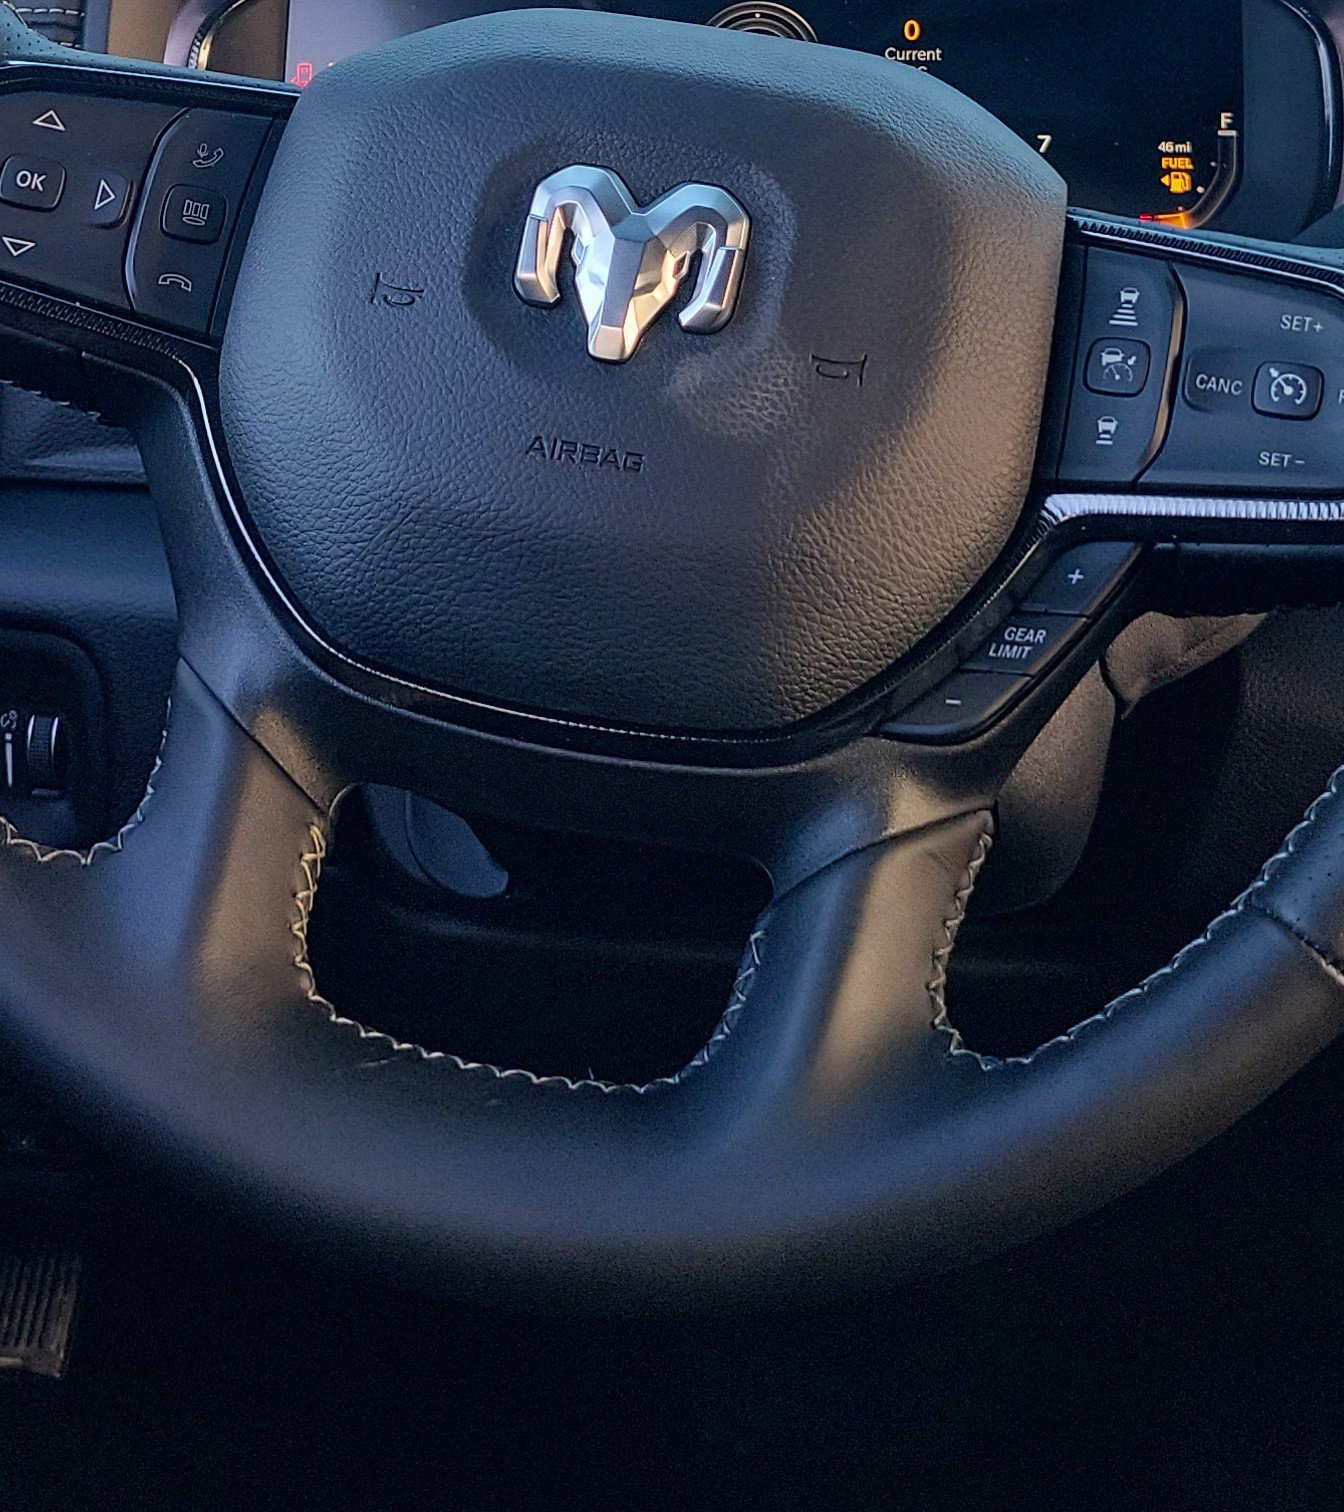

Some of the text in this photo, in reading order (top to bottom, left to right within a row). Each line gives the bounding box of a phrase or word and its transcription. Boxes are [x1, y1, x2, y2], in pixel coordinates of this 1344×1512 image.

[904, 19, 921, 41] 0
[885, 47, 942, 61] Current
[1221, 112, 1234, 129] F
[1037, 135, 1052, 153] 7
[1161, 158, 1194, 170] FUEL
[15, 170, 47, 192] OK
[1195, 373, 1243, 396] CANC
[524, 435, 644, 472] AIRBAG
[1004, 626, 1047, 644] GEAR
[988, 643, 1033, 660] LIMIT
